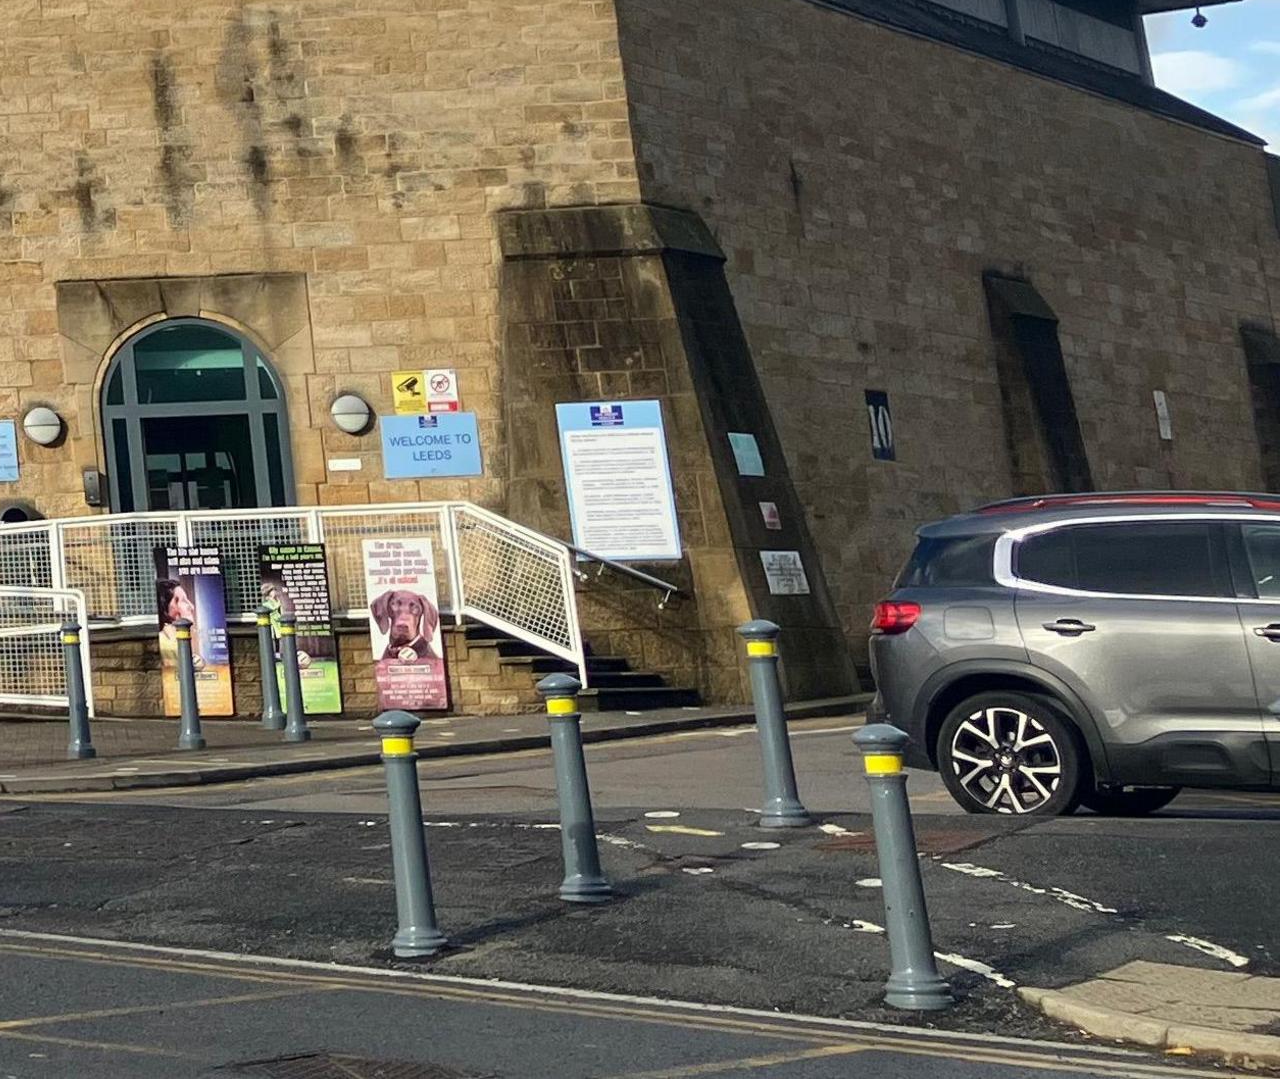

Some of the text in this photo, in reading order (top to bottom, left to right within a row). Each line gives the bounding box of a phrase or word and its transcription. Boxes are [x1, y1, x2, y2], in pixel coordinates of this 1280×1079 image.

[868, 405, 892, 448] 10
[389, 433, 472, 447] WELCOME TO
[412, 450, 452, 461] LEEDS
